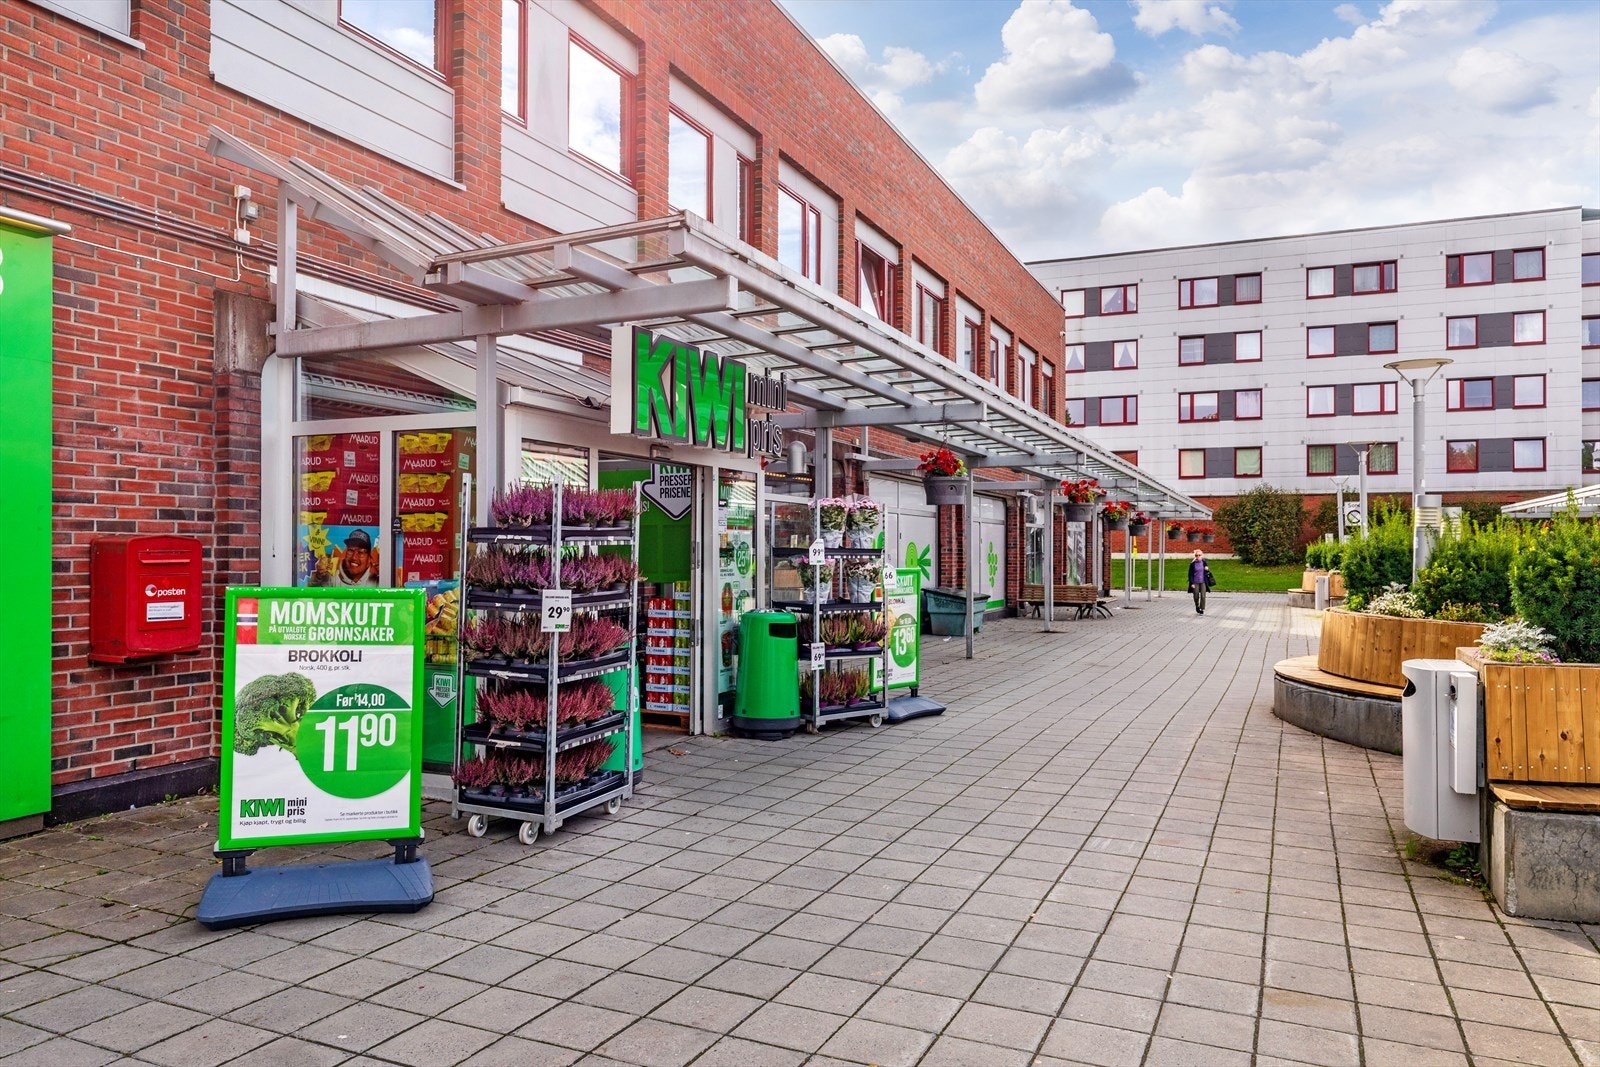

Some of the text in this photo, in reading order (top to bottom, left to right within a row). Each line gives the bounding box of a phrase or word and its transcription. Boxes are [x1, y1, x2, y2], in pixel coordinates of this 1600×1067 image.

[631, 325, 746, 454] KIWI
[748, 367, 788, 411] mini
[349, 434, 379, 444] MAARUD
[747, 413, 783, 459] pris
[403, 459, 437, 470] MAARUD
[348, 473, 379, 484] MAARUD
[401, 498, 435, 509] MAARUD
[340, 514, 373, 524] MAARUD
[403, 537, 433, 548] MAARUD
[412, 554, 444, 566] MAARUD
[157, 588, 186, 598] posten
[270, 601, 394, 626] MOMSKUTT
[268, 625, 306, 634] PÅ UTVALGTE
[308, 626, 394, 642] GRØNNSAKER
[283, 633, 306, 641] NORSKE
[288, 650, 362, 662] BROKKOLI
[336, 694, 354, 707] Før
[287, 797, 307, 807] mini
[240, 798, 286, 818] KIWI
[287, 806, 305, 818] pris
